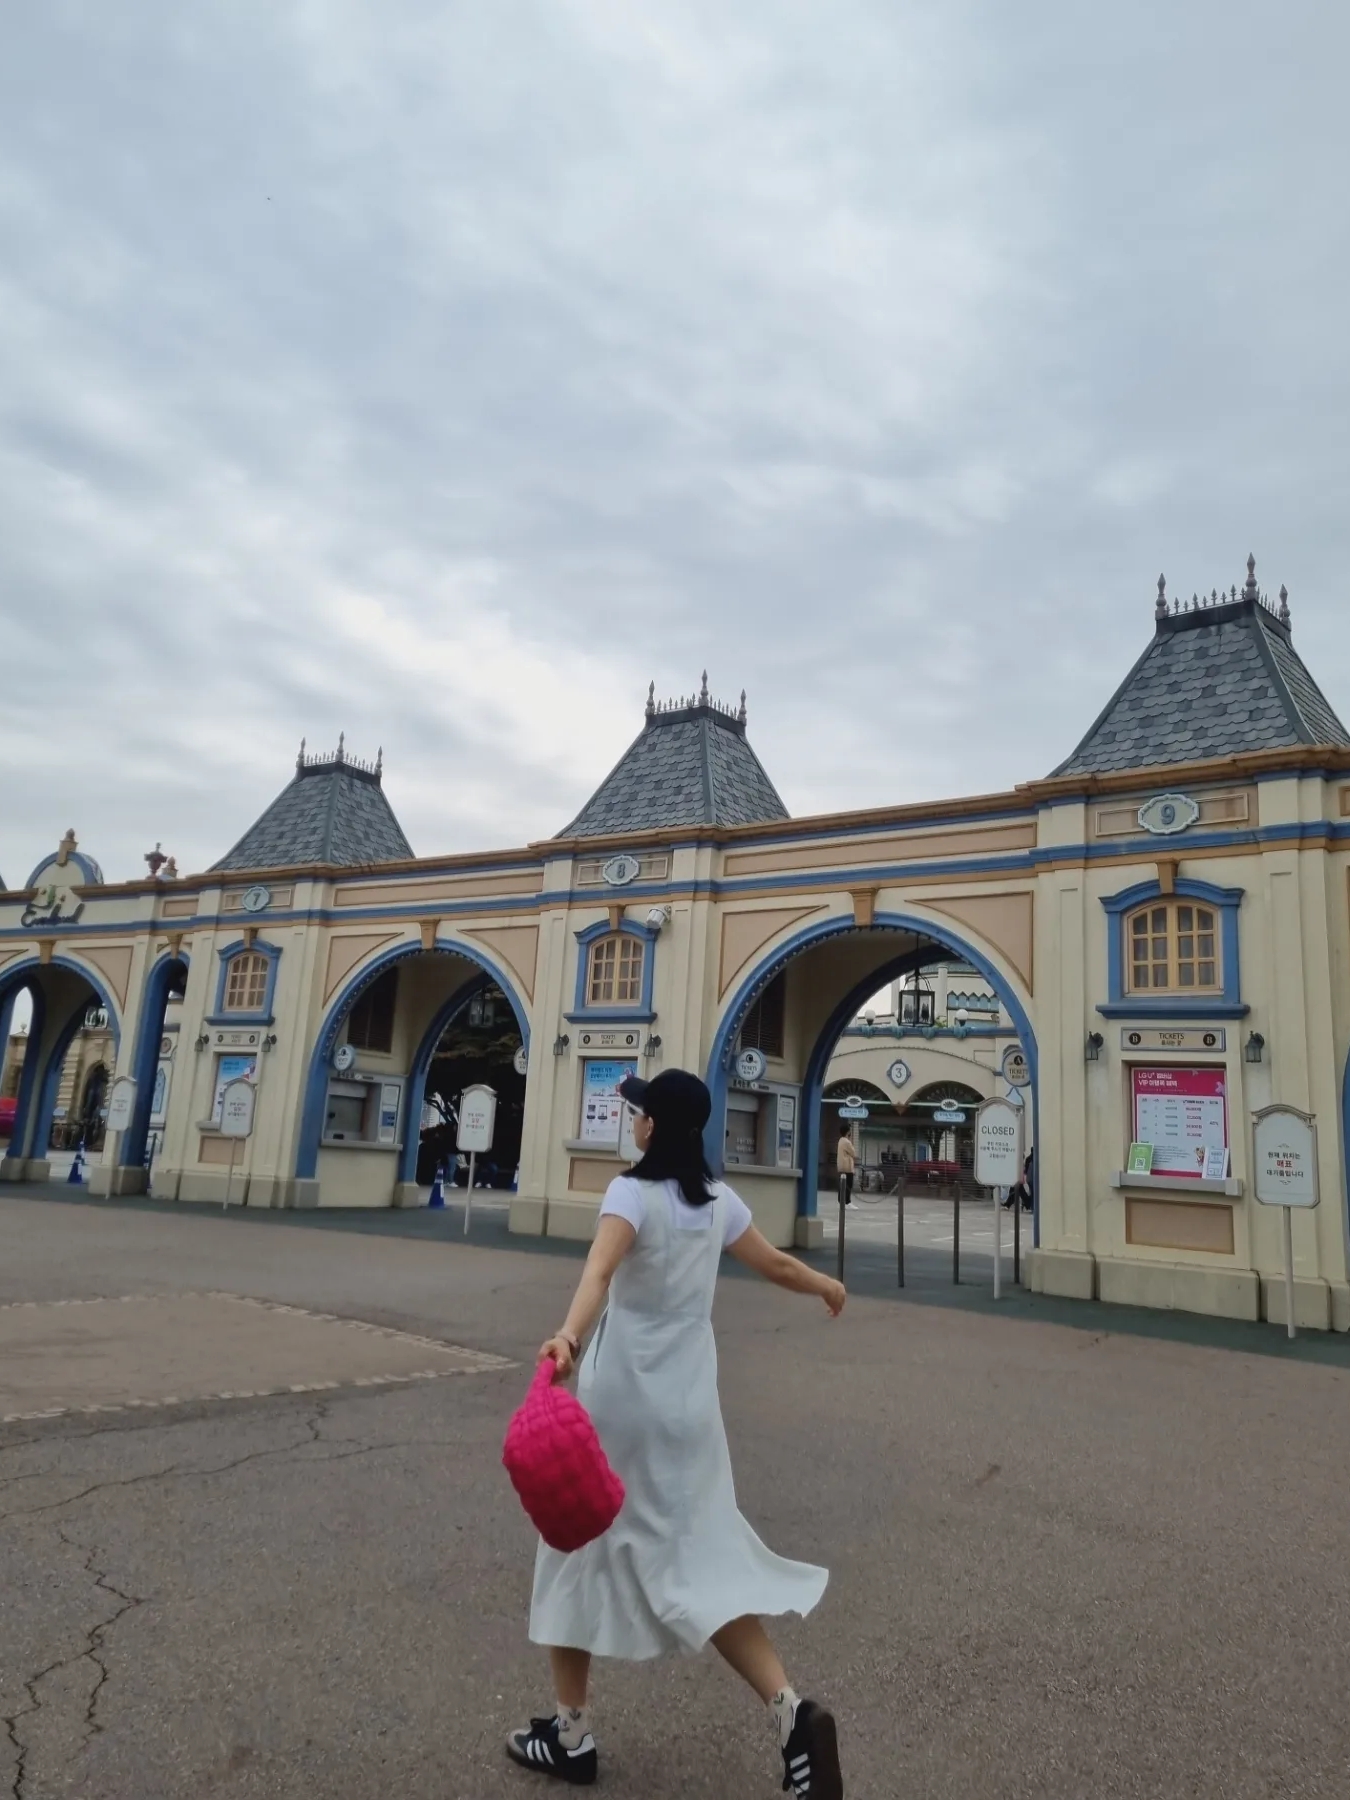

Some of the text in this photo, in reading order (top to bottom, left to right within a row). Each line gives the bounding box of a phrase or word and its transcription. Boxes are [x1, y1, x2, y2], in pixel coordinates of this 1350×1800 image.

[1161, 804, 1175, 824] 9
[253, 892, 261, 906] 7
[895, 1067, 903, 1079] 3
[981, 1126, 1015, 1136] CLOSED
[1277, 1160, 1292, 1168] 매표
